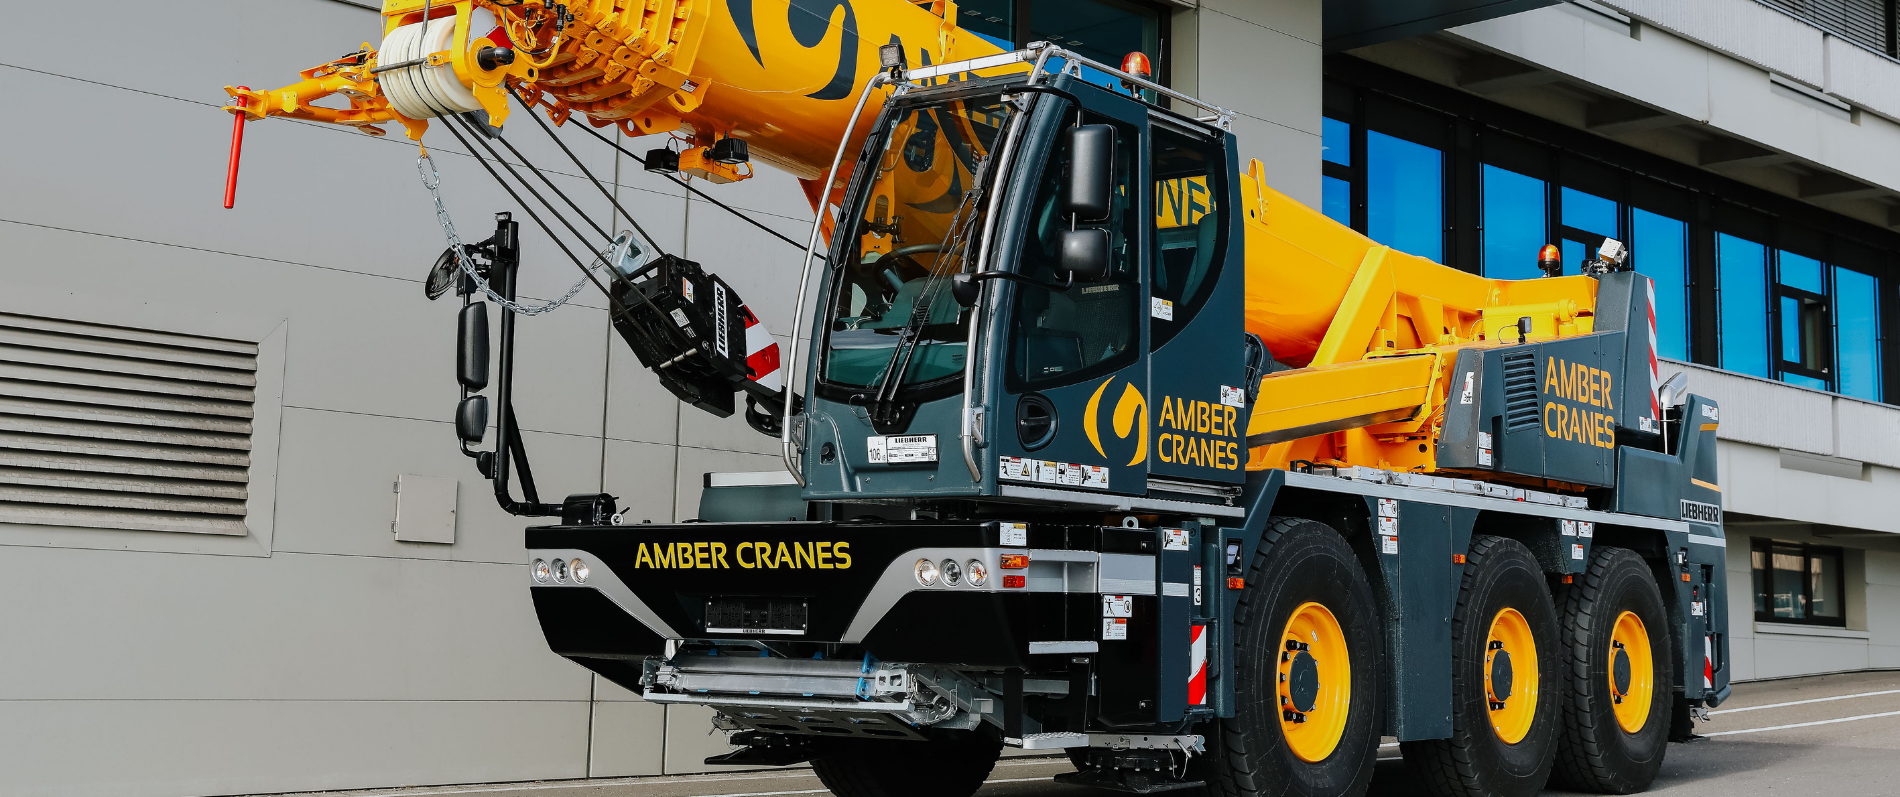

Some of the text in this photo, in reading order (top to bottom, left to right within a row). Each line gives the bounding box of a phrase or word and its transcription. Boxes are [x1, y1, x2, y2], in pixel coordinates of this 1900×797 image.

[716, 286, 727, 354] LIEBHERR
[1544, 356, 1613, 410] AMBER
[1158, 395, 1238, 438] AMBER
[1544, 401, 1615, 450] CRANES
[869, 448, 881, 461] 106
[894, 436, 928, 444] LIEBHERR
[1158, 432, 1239, 471] CRANES
[1681, 501, 1719, 523] LIEBHERR
[635, 541, 852, 569] AMBER CRANES
